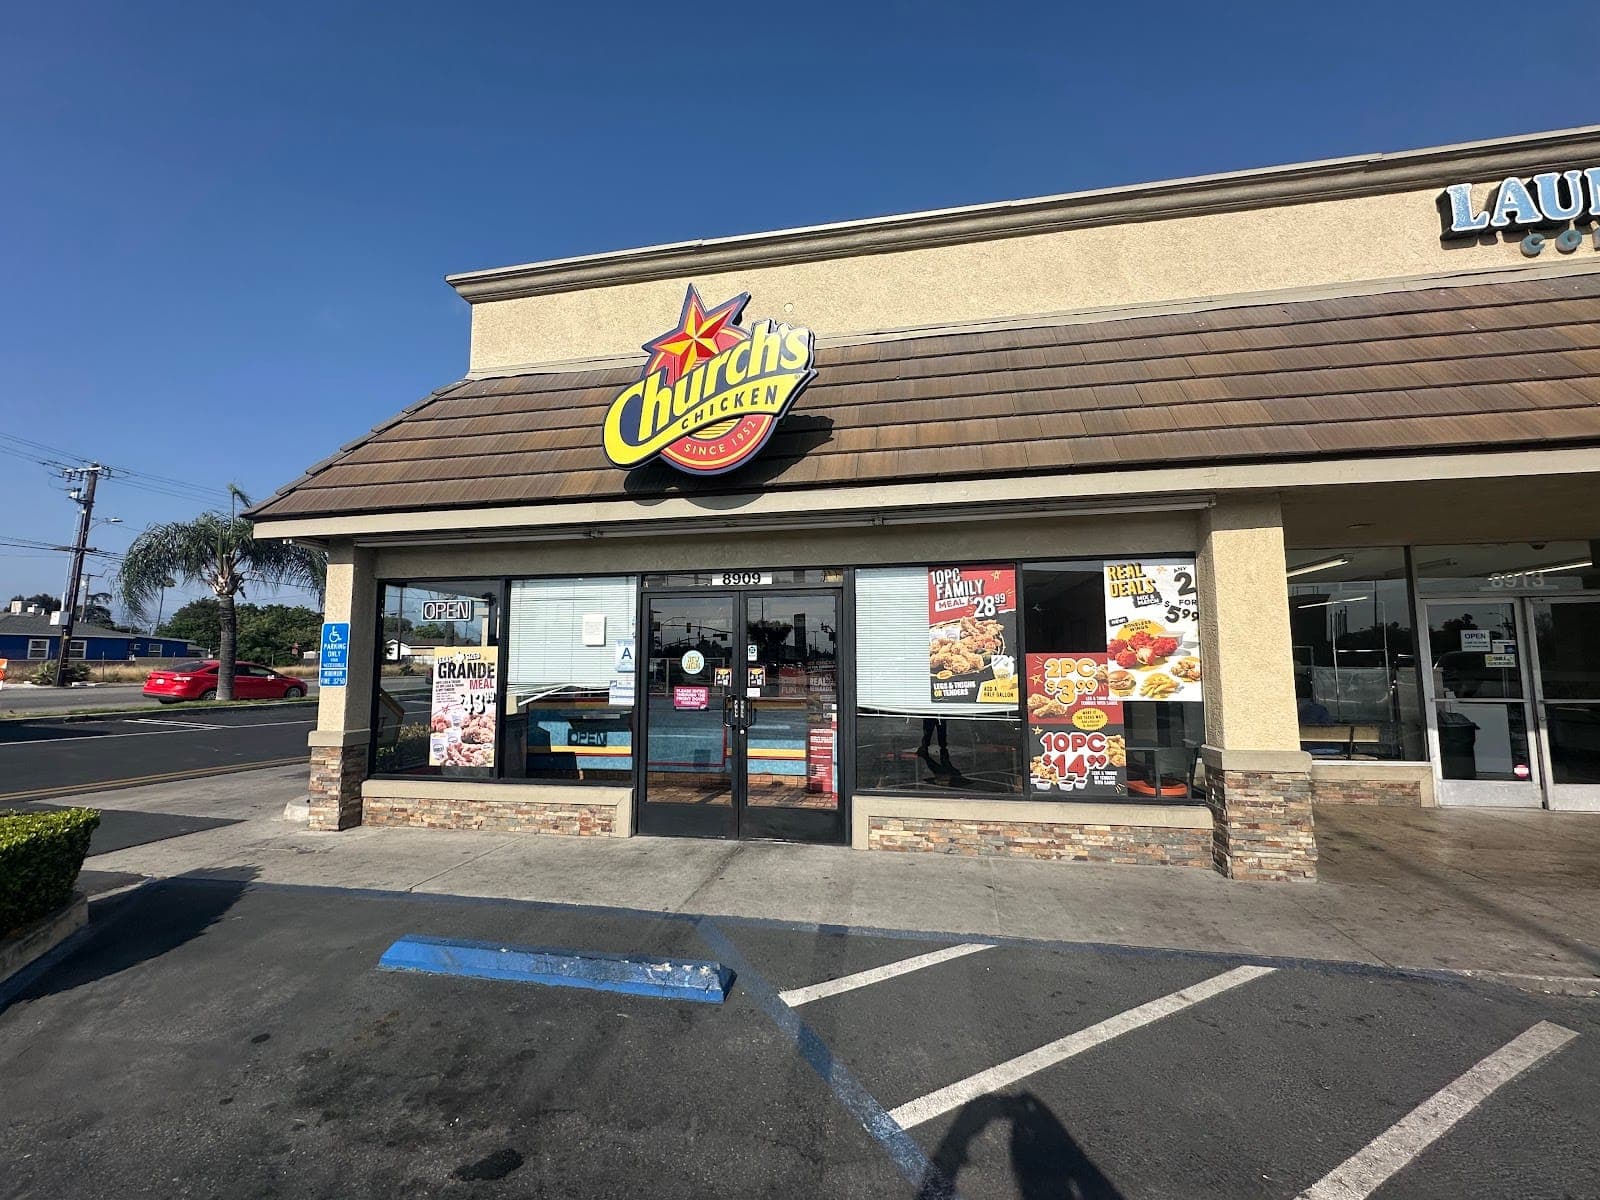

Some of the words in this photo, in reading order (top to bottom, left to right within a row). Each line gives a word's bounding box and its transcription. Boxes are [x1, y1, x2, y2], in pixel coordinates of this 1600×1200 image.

[604, 319, 809, 465] Church's
[681, 384, 778, 430] CHICKEN
[684, 443, 726, 456] SINCE
[732, 420, 756, 446] 1952
[722, 572, 761, 585] 8909
[1108, 563, 1146, 581] REAL
[1173, 566, 1187, 574] ANY
[1173, 572, 1197, 596] 2
[1491, 571, 1545, 588] 8913
[936, 579, 984, 600] FAMILY
[1110, 579, 1156, 598] DEALS
[424, 602, 468, 619] OPEN
[938, 599, 966, 609] MEAL
[324, 642, 347, 650] PARKING
[621, 647, 632, 659] A
[438, 662, 495, 679] GRANDE
[1044, 659, 1096, 679] 2PC
[469, 679, 495, 690] MEAL
[943, 688, 969, 697] TENDERS
[1041, 732, 1106, 753] 10PC
